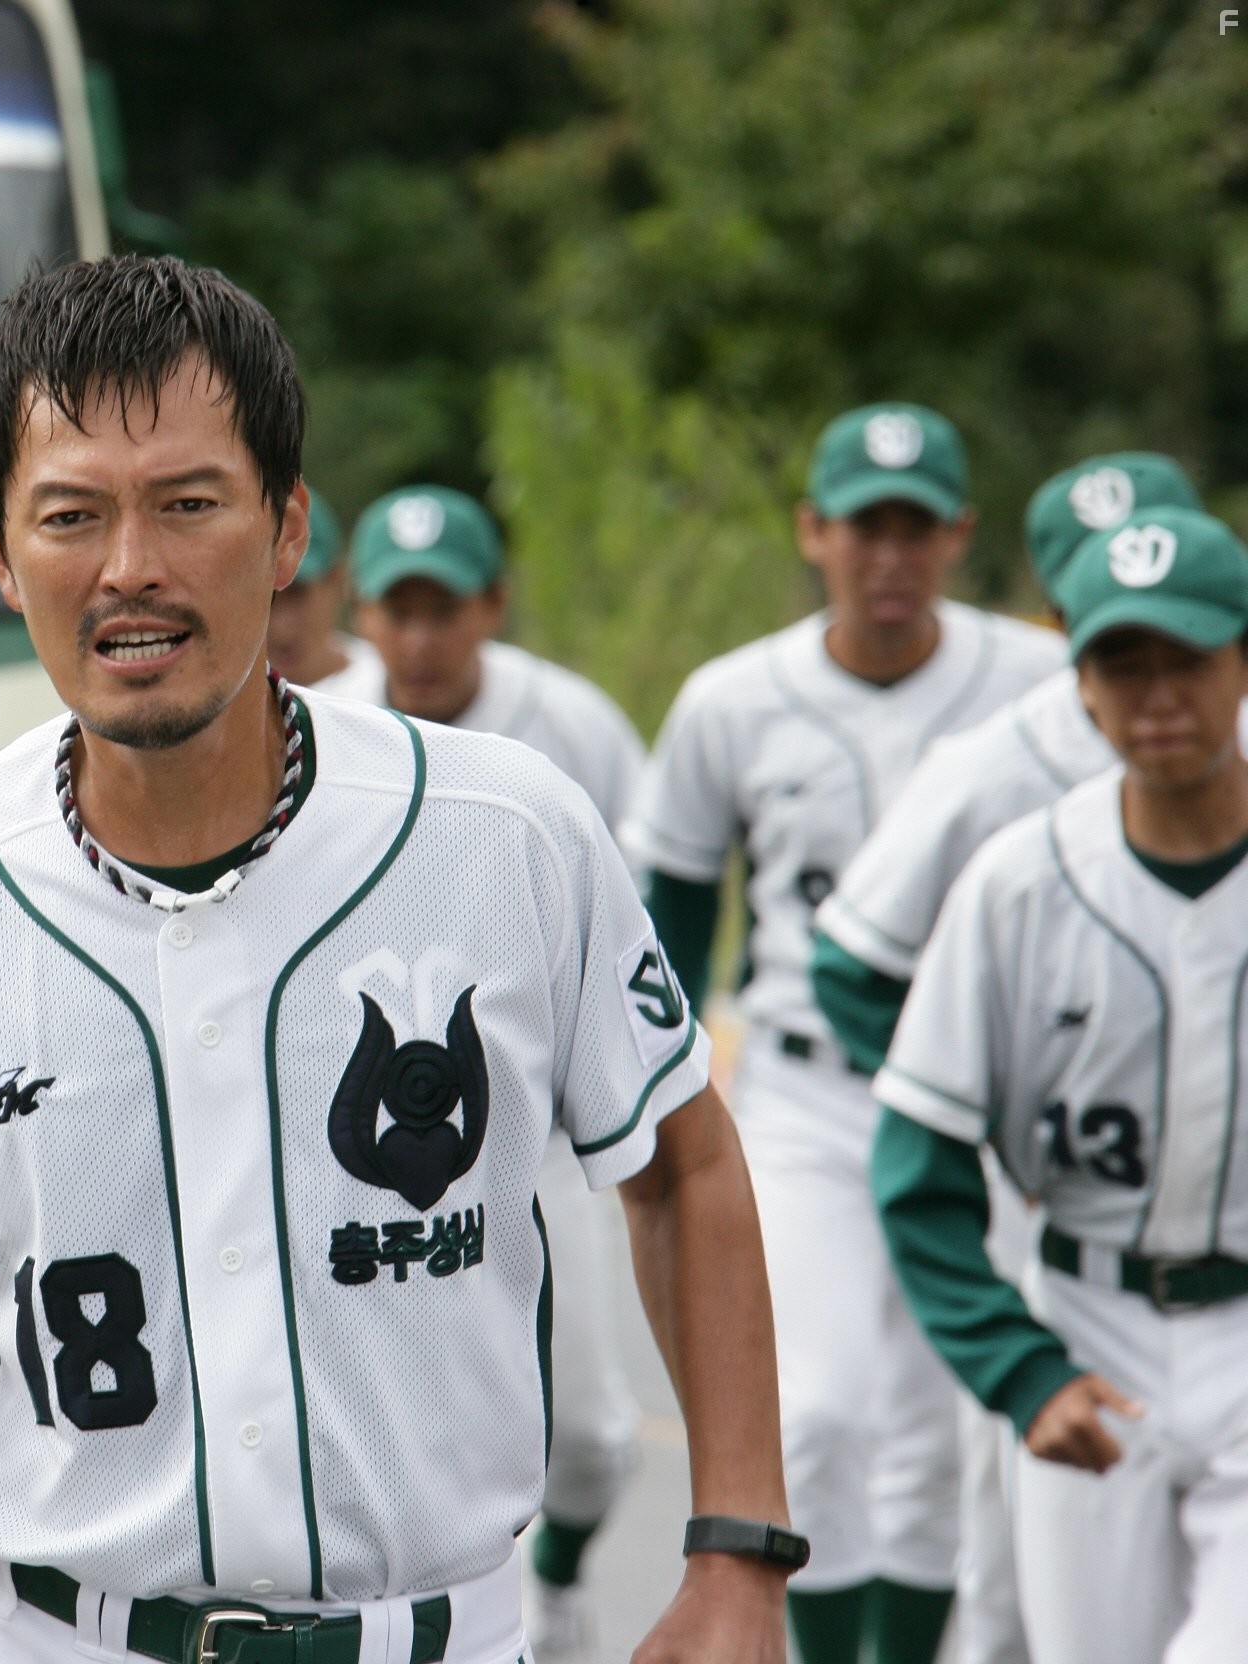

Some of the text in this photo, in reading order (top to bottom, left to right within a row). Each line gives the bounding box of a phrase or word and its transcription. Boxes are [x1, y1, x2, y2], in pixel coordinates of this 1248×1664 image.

[1041, 1101, 1147, 1190] 13
[328, 1202, 485, 1286] 충주성심
[14, 1252, 158, 1431] 18
